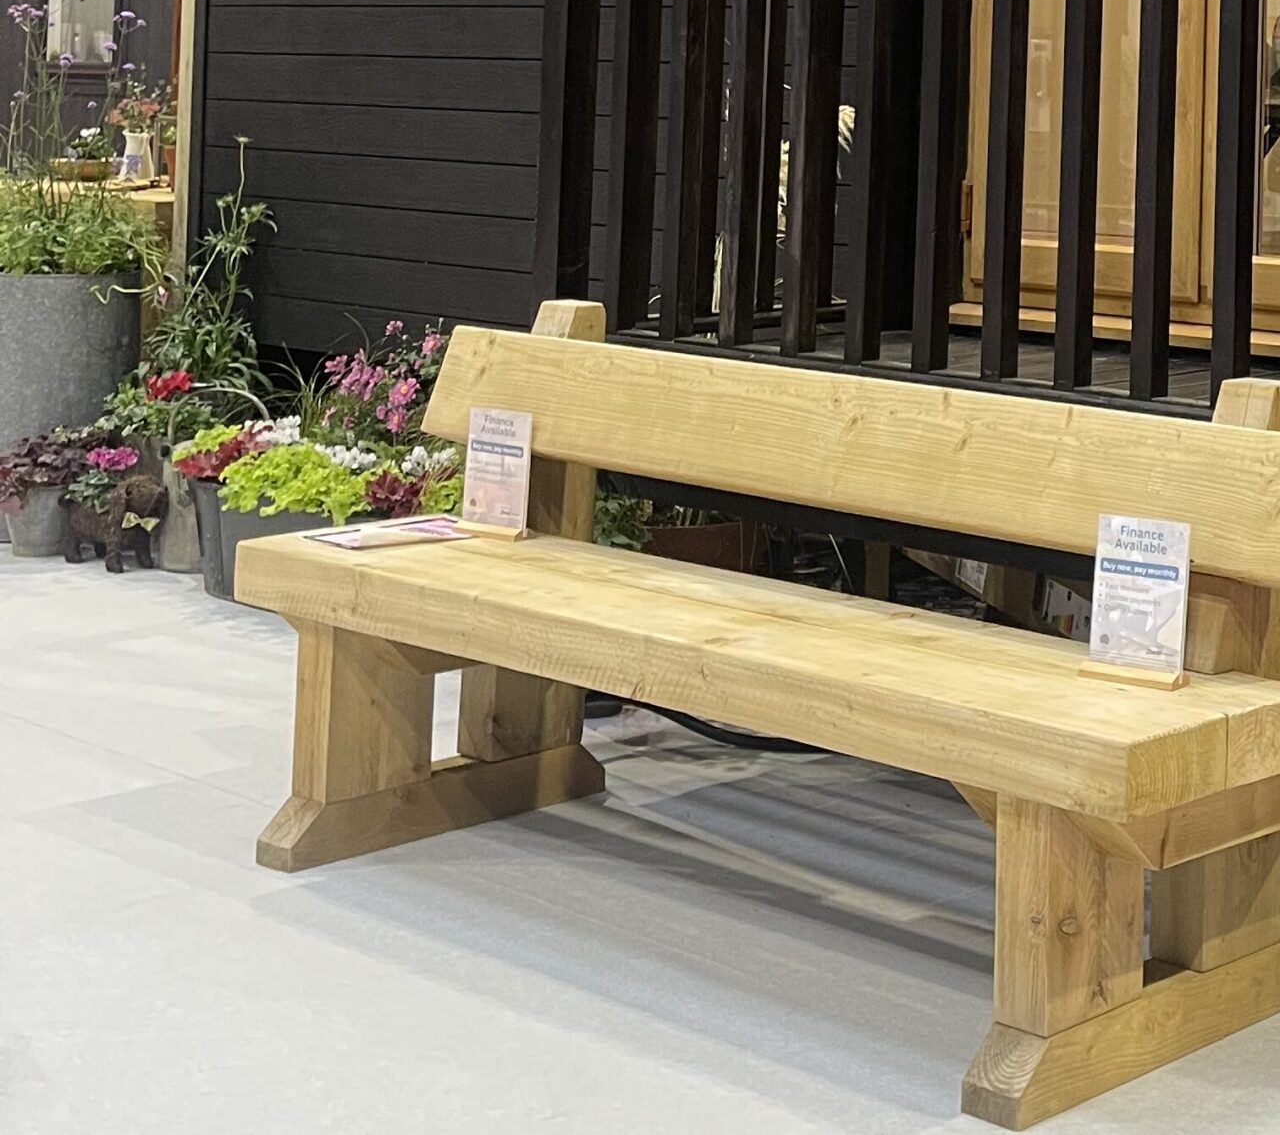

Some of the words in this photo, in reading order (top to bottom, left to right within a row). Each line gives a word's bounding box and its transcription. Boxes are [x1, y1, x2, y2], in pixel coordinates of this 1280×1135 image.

[484, 414, 514, 427] Finance
[480, 425, 517, 438] Available
[1120, 525, 1165, 542] Finance
[1114, 538, 1168, 555] Available
[1102, 561, 1116, 571] Buy
[1133, 566, 1147, 576] pay
[1147, 568, 1177, 579] monthly
